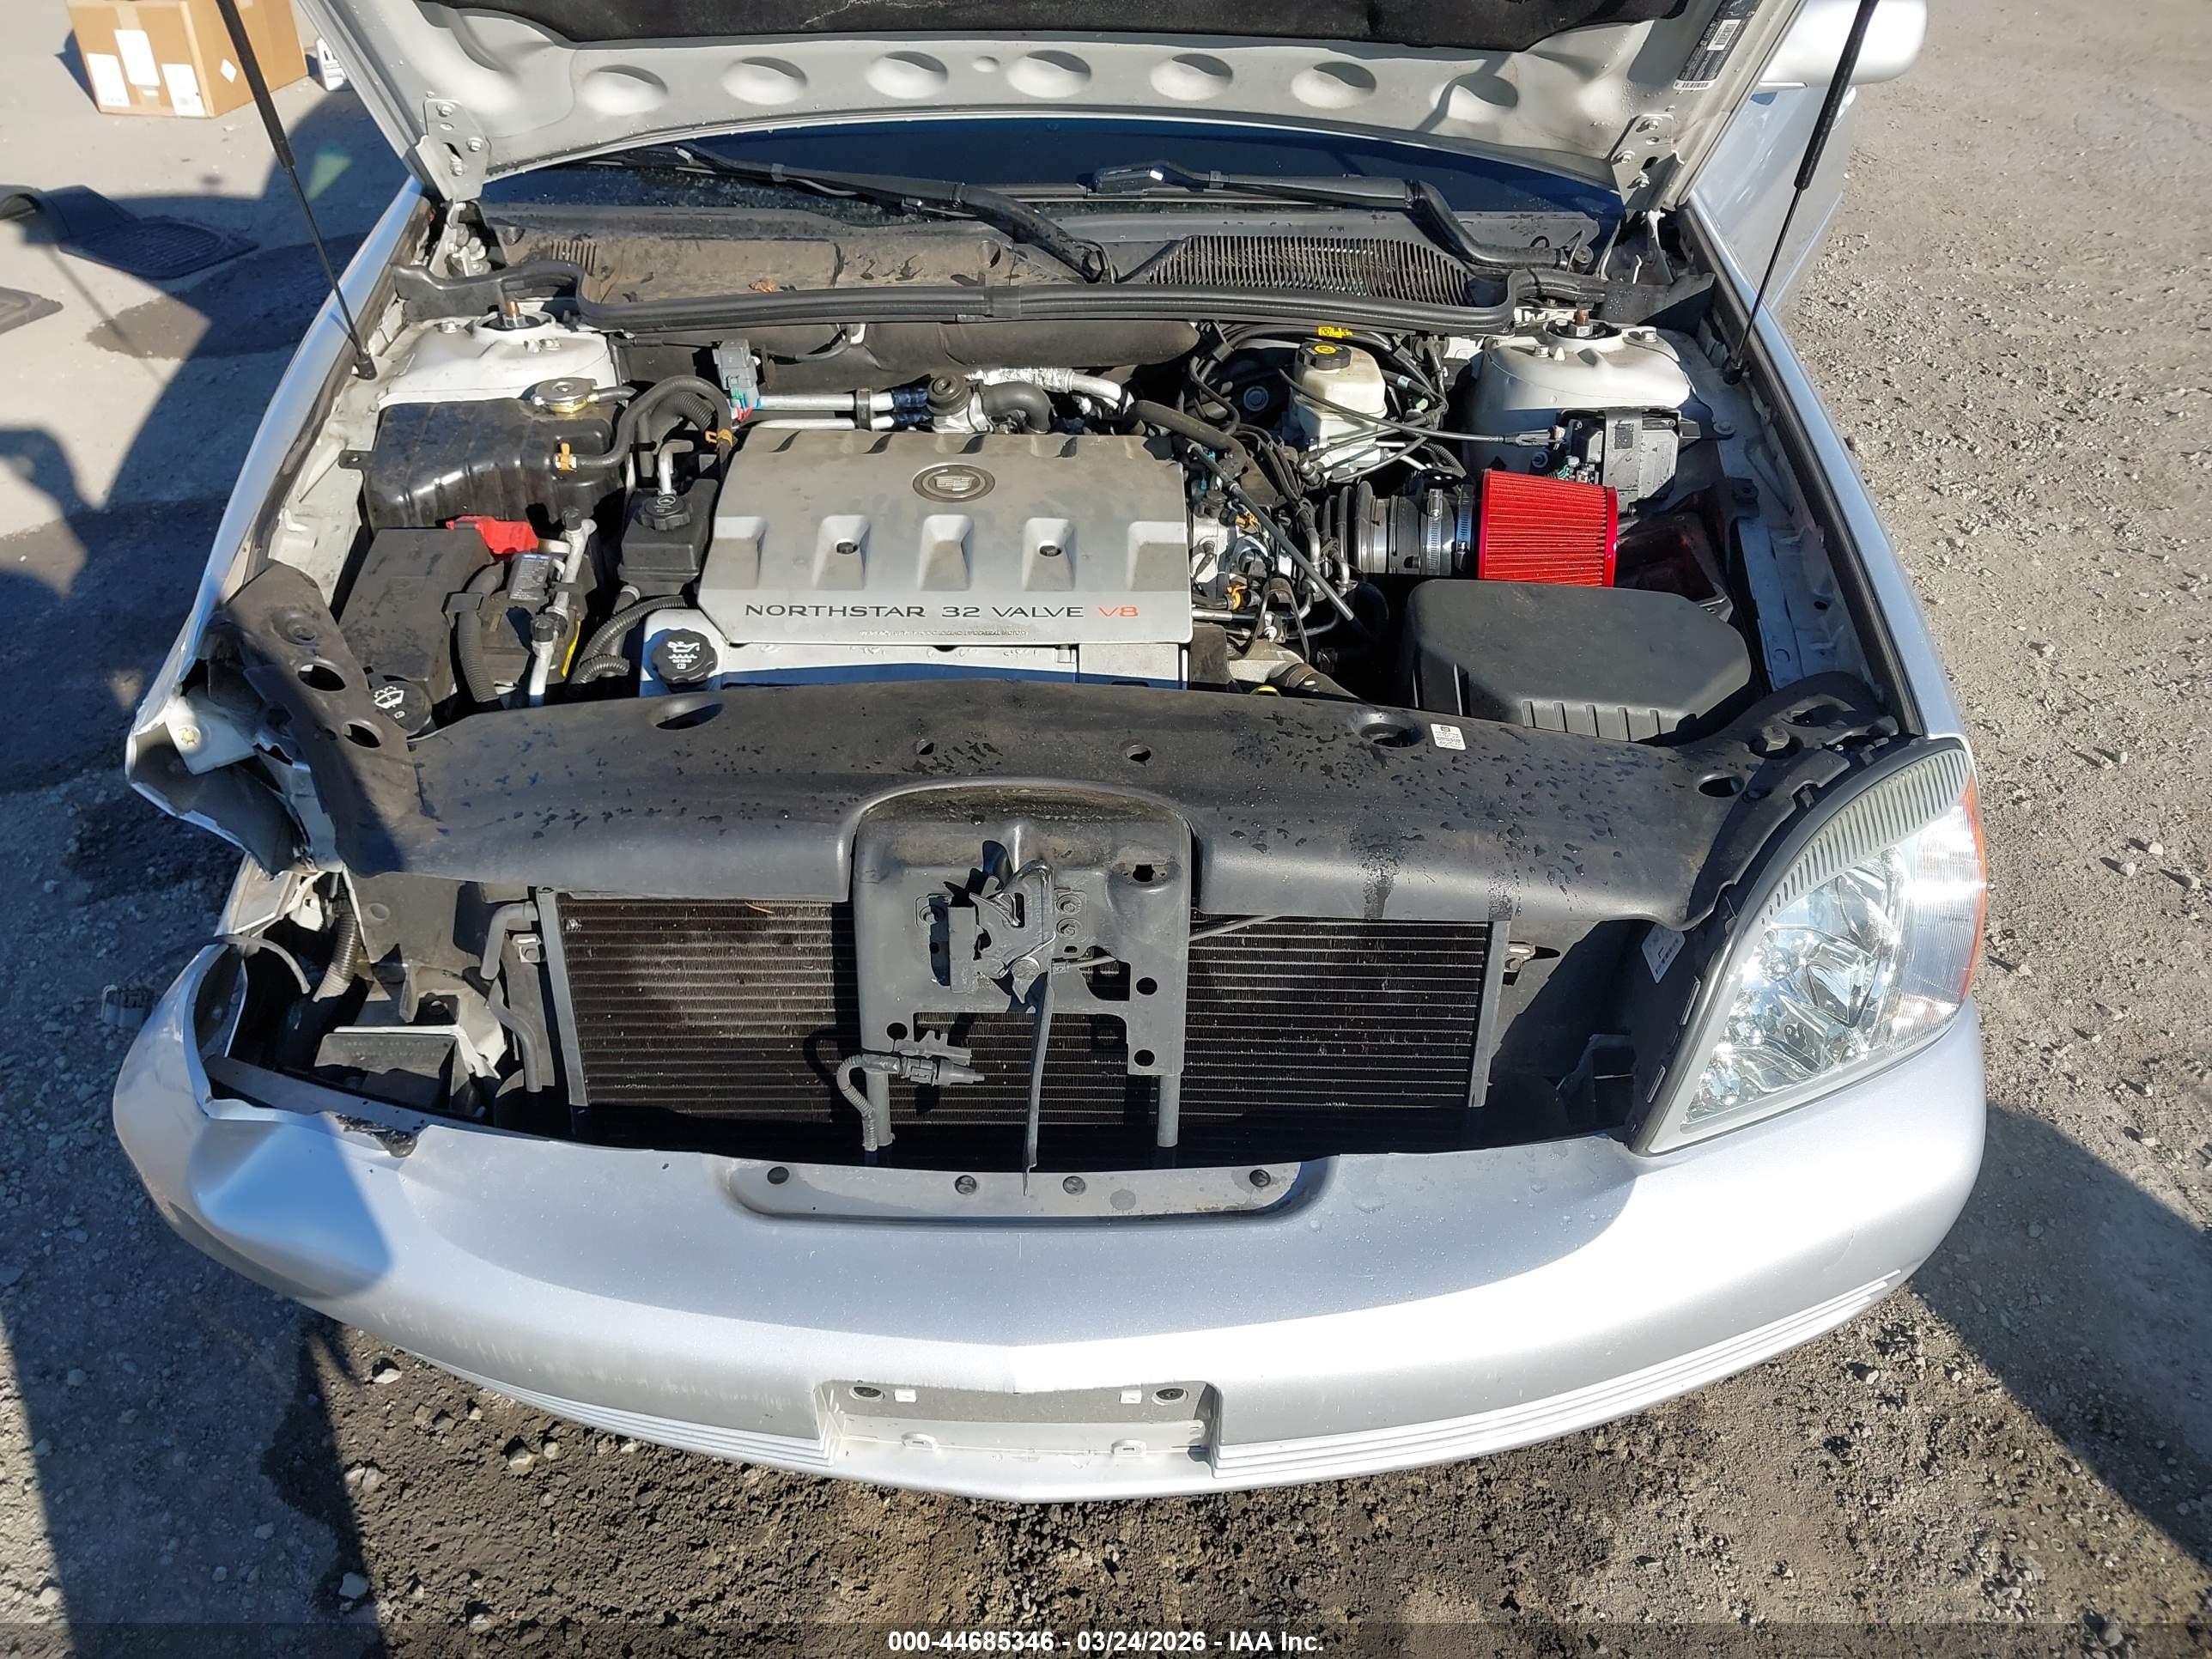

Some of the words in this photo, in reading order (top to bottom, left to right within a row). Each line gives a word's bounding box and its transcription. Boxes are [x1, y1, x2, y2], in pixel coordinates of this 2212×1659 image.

[745, 604, 926, 617] NORTHSTAR
[941, 606, 981, 617] 32
[991, 606, 1084, 617] VALVE
[1098, 606, 1139, 617] V8
